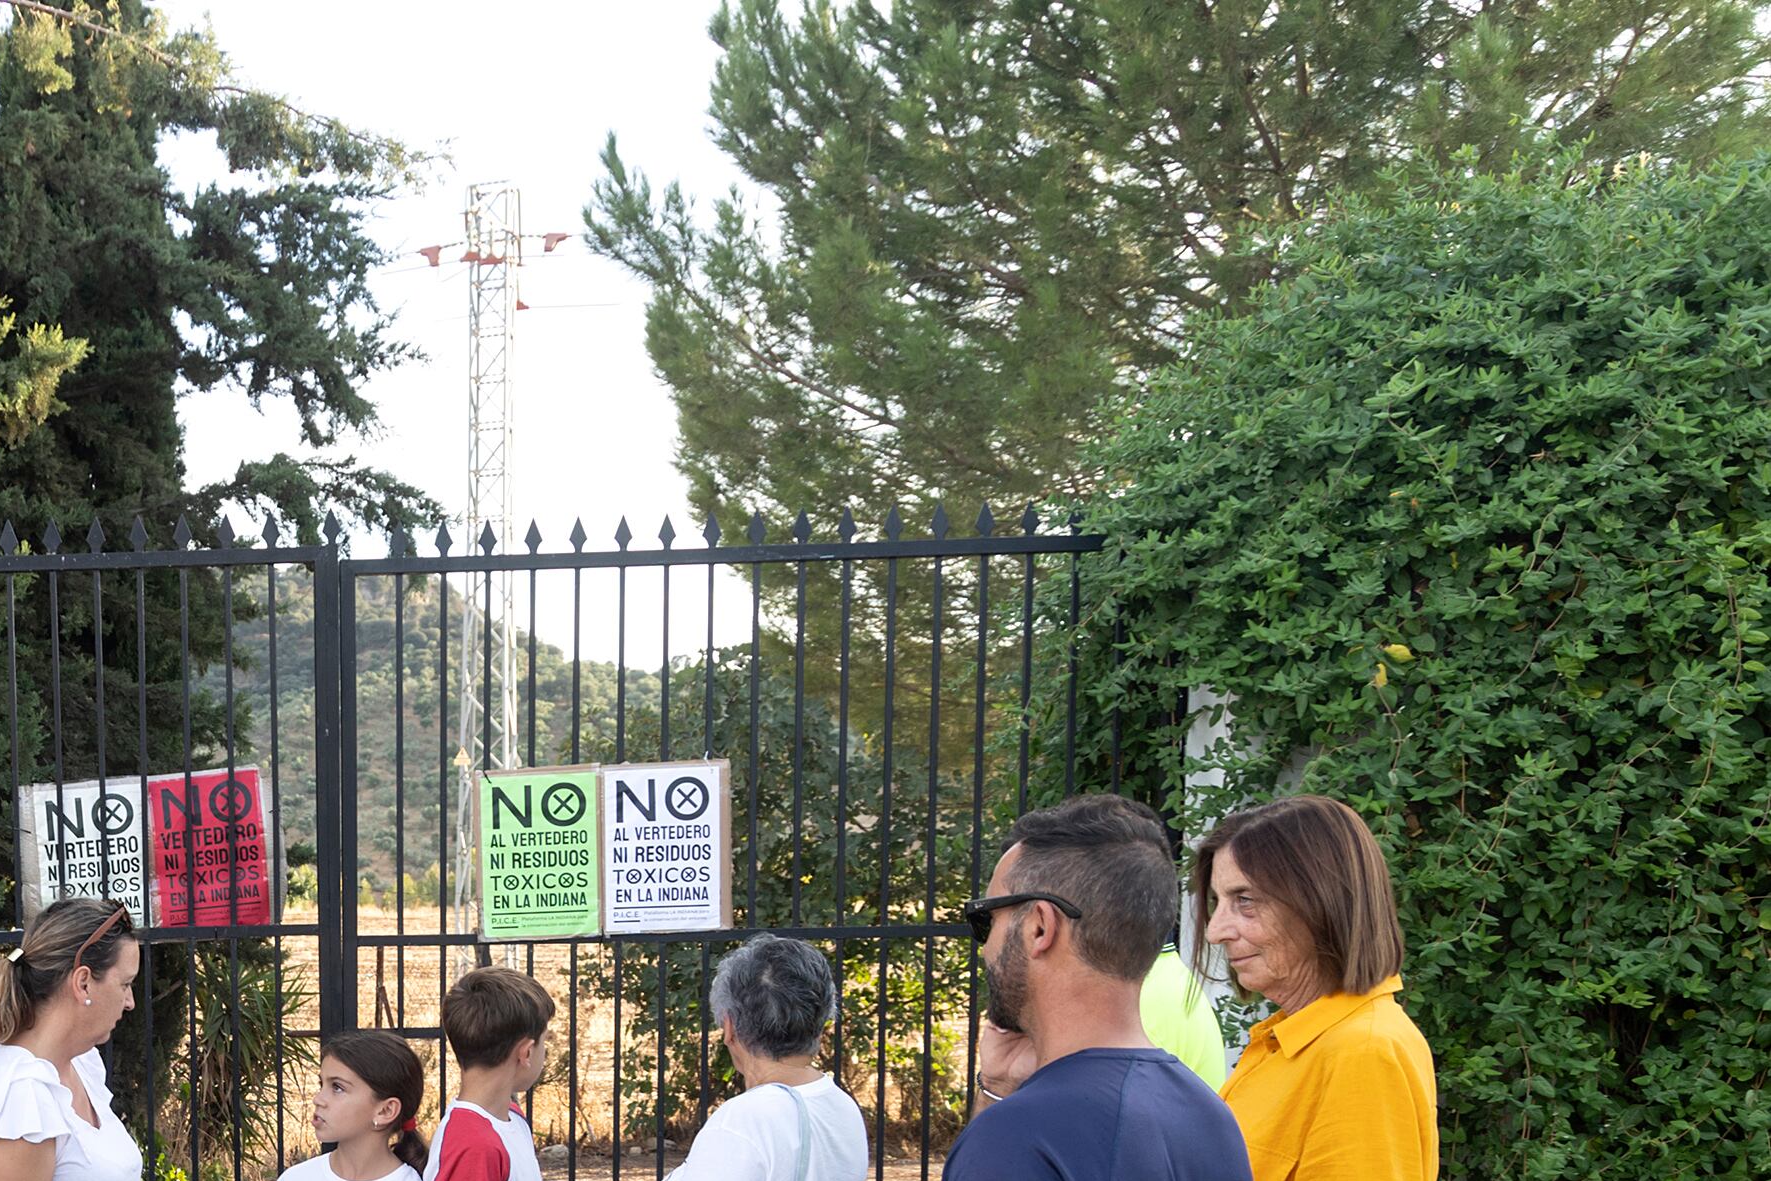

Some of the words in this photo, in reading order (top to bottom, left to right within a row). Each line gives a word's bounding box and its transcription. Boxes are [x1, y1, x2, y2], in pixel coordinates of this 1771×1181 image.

[160, 780, 252, 829] NO
[492, 782, 586, 829] NO
[616, 776, 710, 823] NO
[45, 793, 134, 841] NO
[490, 834, 506, 848] AL
[511, 829, 588, 847] VERTEDERO
[614, 828, 629, 841] AL
[635, 824, 710, 840] VERTEDERO
[164, 853, 179, 870] NI
[185, 845, 259, 869] ESIDOS
[490, 853, 504, 870] NI
[512, 849, 589, 869] RESIDUOS
[613, 847, 628, 863] NI
[635, 843, 711, 863] RESIDUOS
[68, 857, 140, 879] RESIUOS
[613, 866, 710, 885] TOXICOS
[490, 872, 588, 891] TOXICOS
[170, 892, 187, 906] EN
[193, 889, 206, 903] A
[211, 884, 260, 902] INDANA
[493, 895, 510, 909] EN
[515, 894, 531, 908] LA
[536, 892, 587, 907] INDIANA
[616, 888, 632, 903] EN
[637, 888, 653, 902] LA
[658, 886, 709, 901] INDIANA
